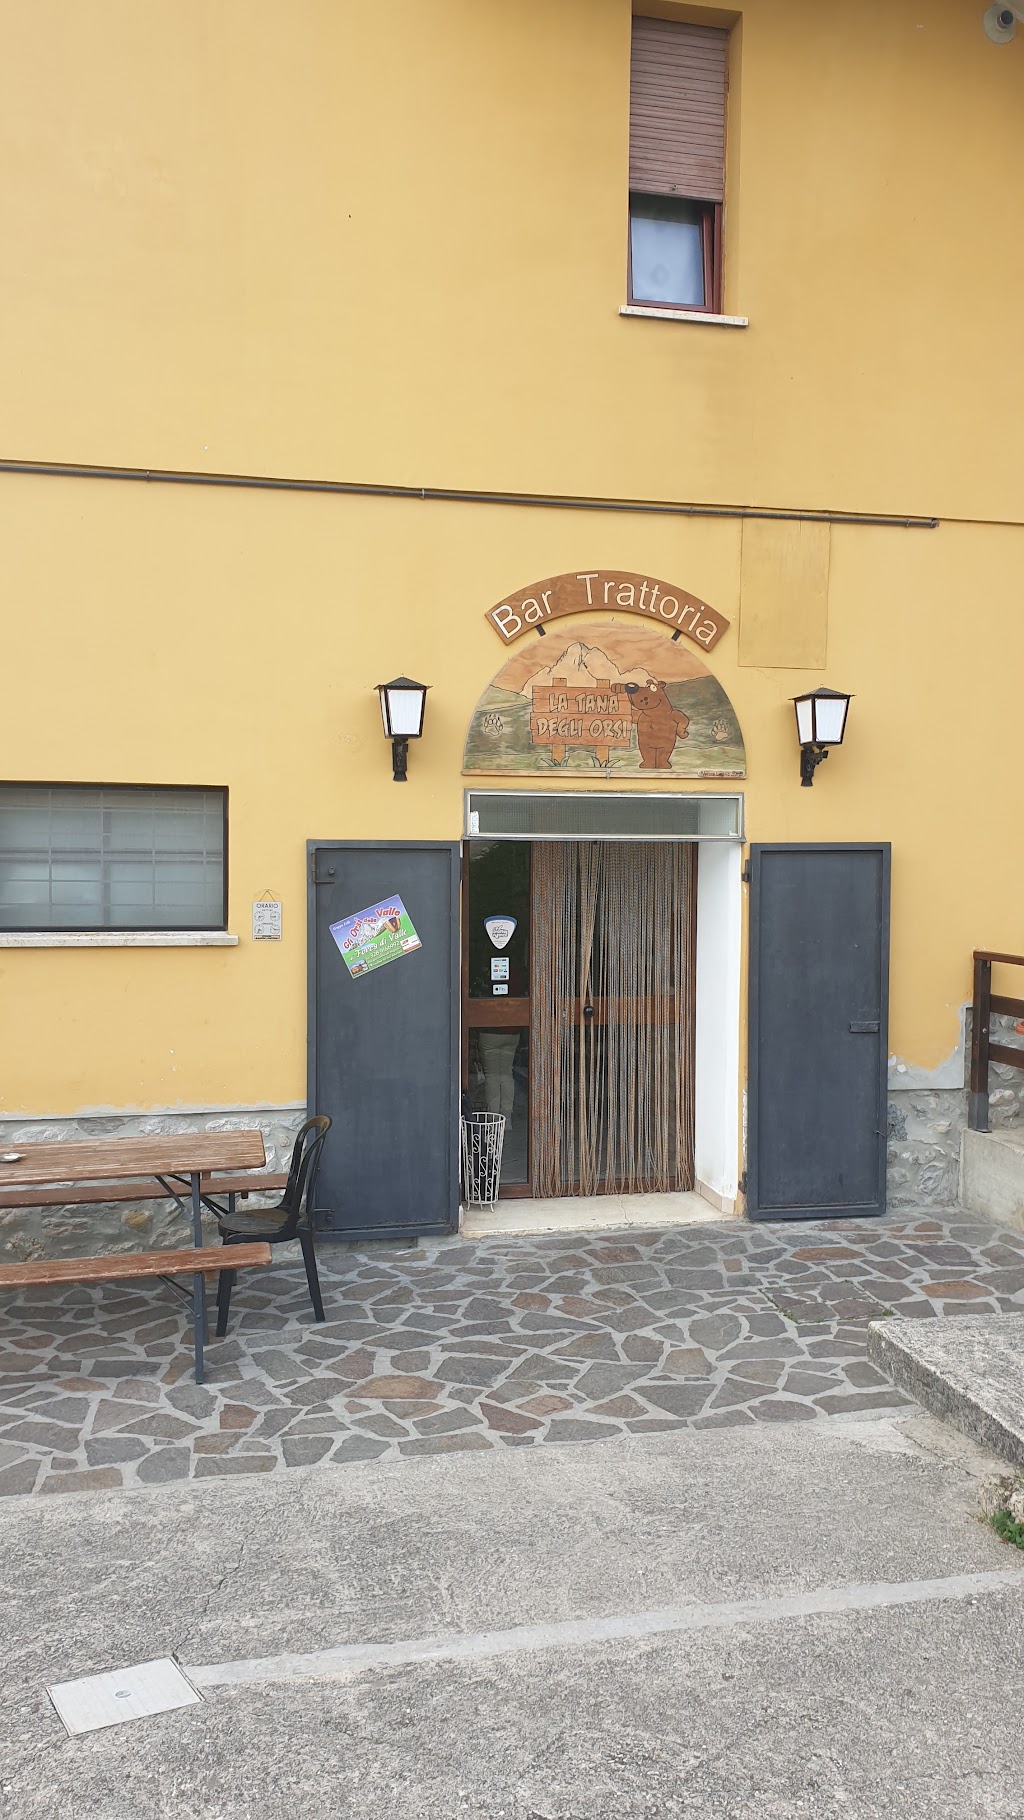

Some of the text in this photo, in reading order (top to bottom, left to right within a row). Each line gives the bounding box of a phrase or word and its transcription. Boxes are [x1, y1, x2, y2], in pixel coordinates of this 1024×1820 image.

[491, 573, 719, 645] Bar Trattoria
[549, 692, 619, 714] LA TANA
[536, 717, 627, 739] DEGLI ORSI
[343, 937, 354, 949] Gli
[349, 917, 363, 938] Orsi
[375, 907, 401, 918] Valle
[379, 936, 387, 946] di
[388, 930, 407, 941] Valle
